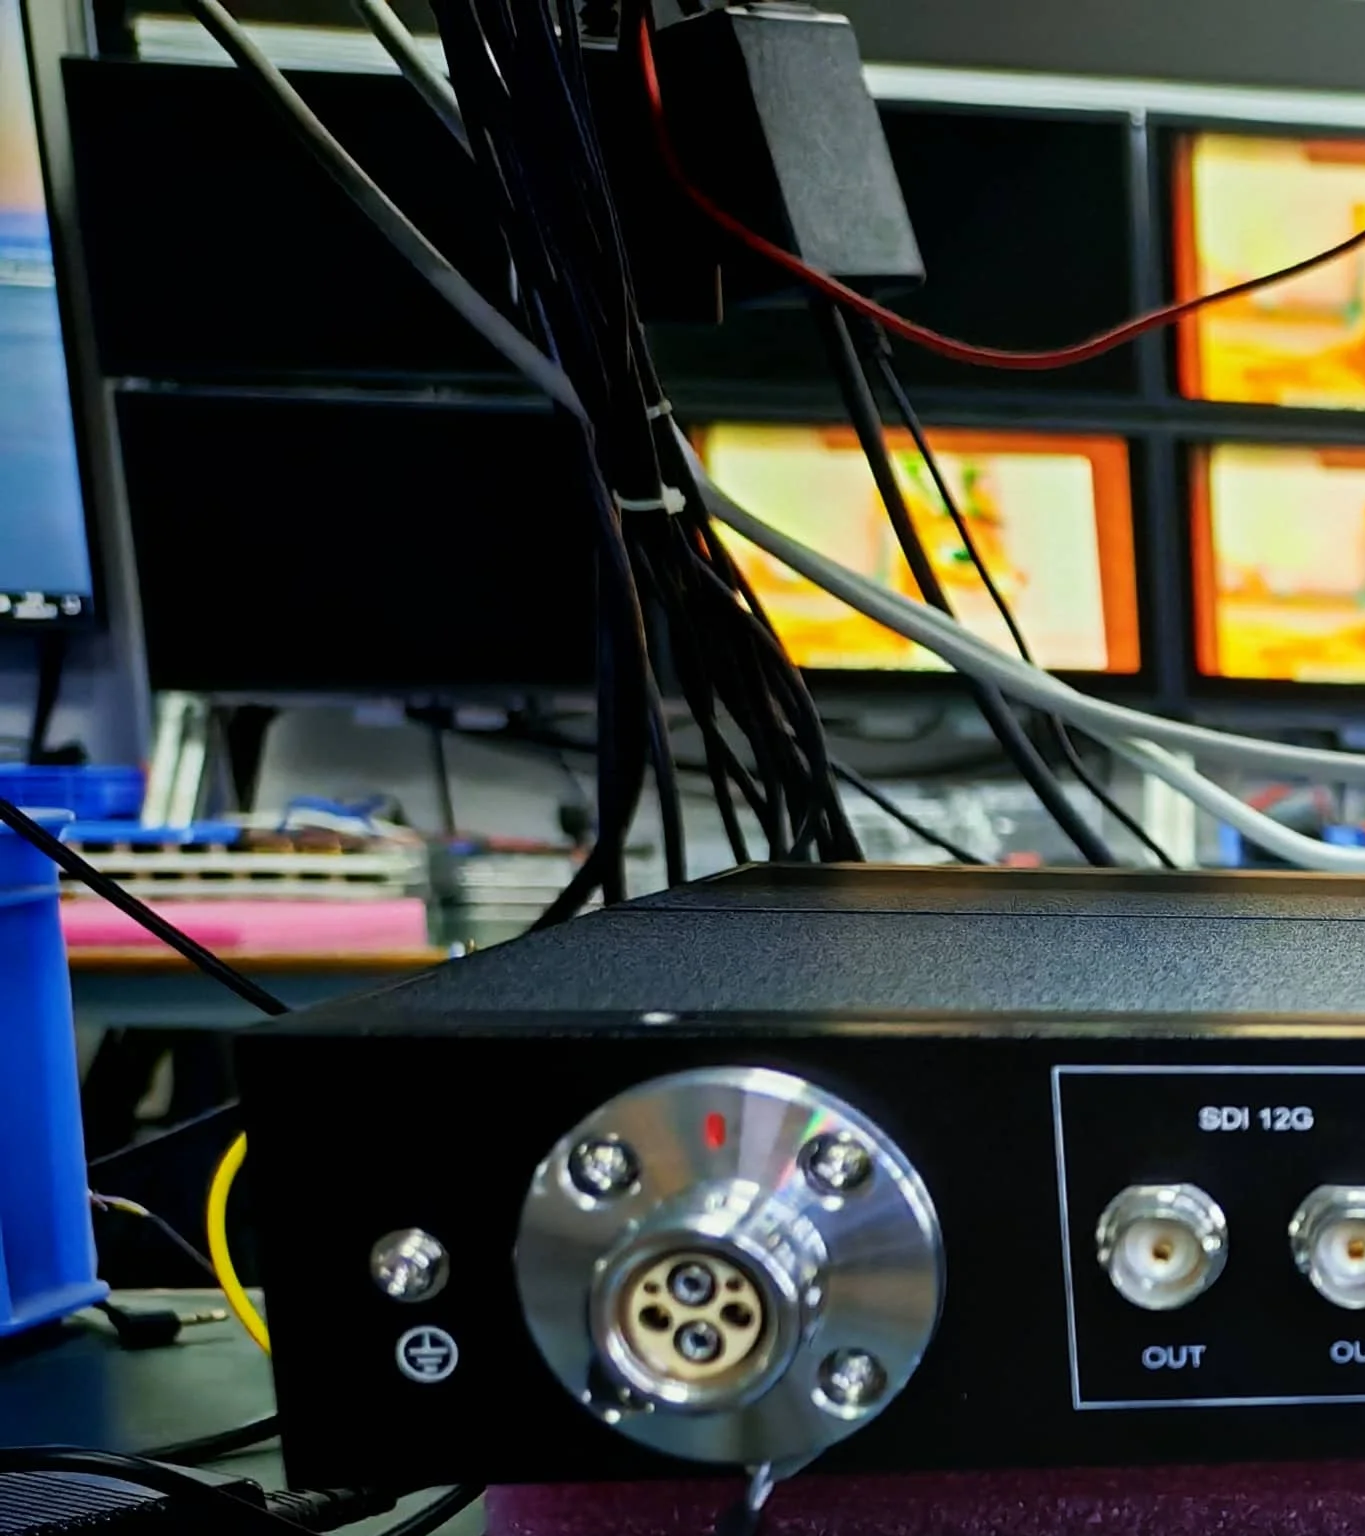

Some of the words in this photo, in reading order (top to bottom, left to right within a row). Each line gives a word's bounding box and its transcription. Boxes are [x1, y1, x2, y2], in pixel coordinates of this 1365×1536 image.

[1199, 1106, 1250, 1131] SDI
[1259, 1106, 1314, 1131] 12G
[1142, 1344, 1207, 1369] OUT
